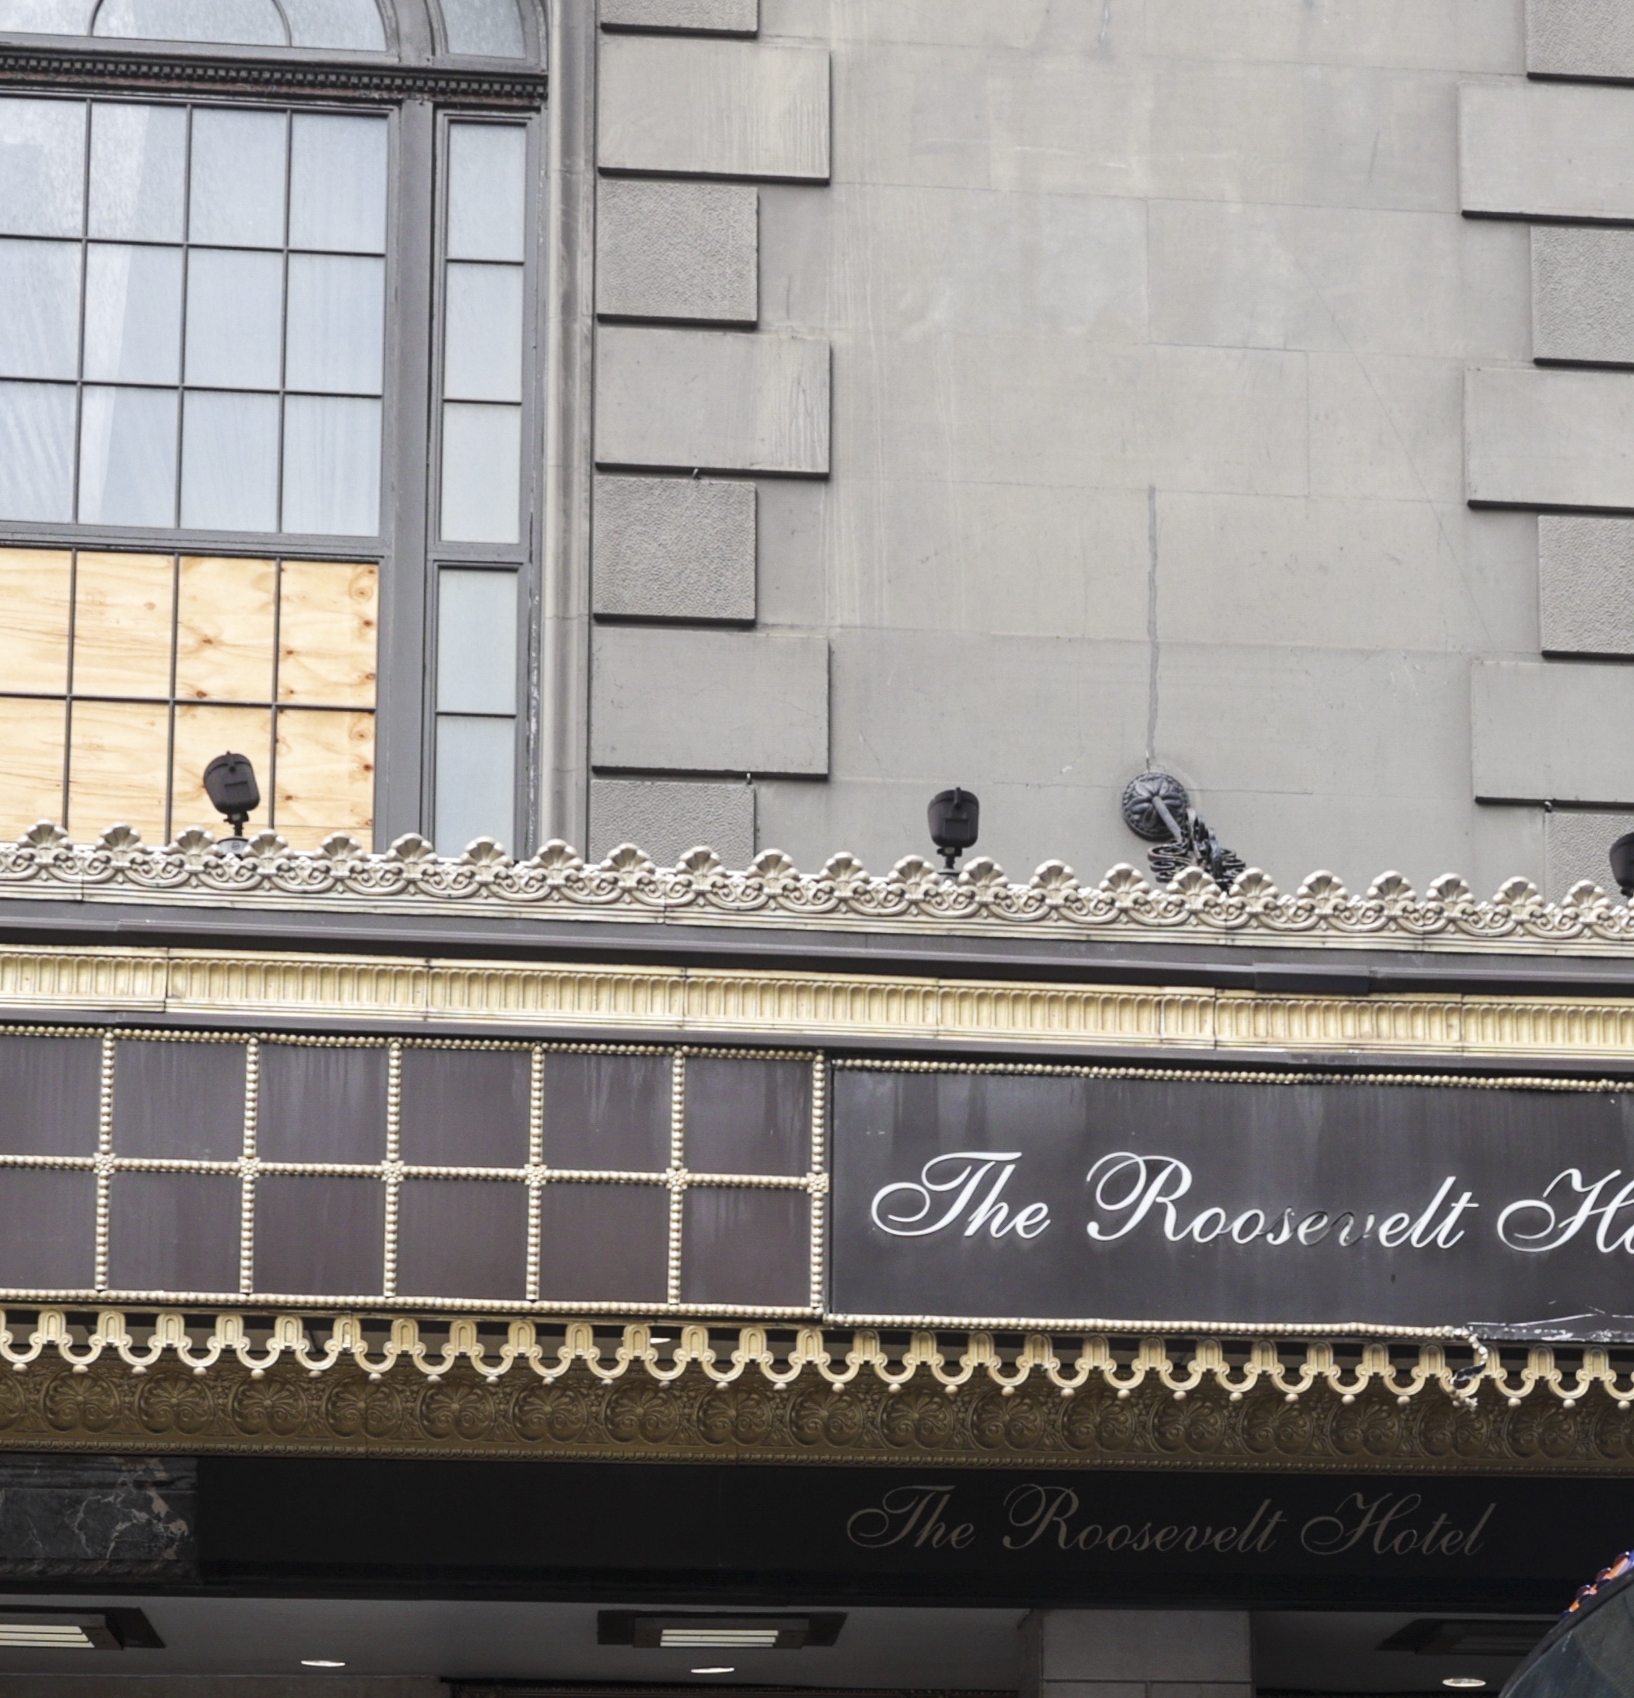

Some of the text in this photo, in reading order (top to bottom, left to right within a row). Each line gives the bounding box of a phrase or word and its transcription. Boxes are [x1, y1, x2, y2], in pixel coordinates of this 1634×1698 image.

[871, 1151, 1051, 1239] The
[1086, 1151, 1480, 1249] Roosevelt
[846, 1484, 1497, 1557] The Roosevelt Hotel
